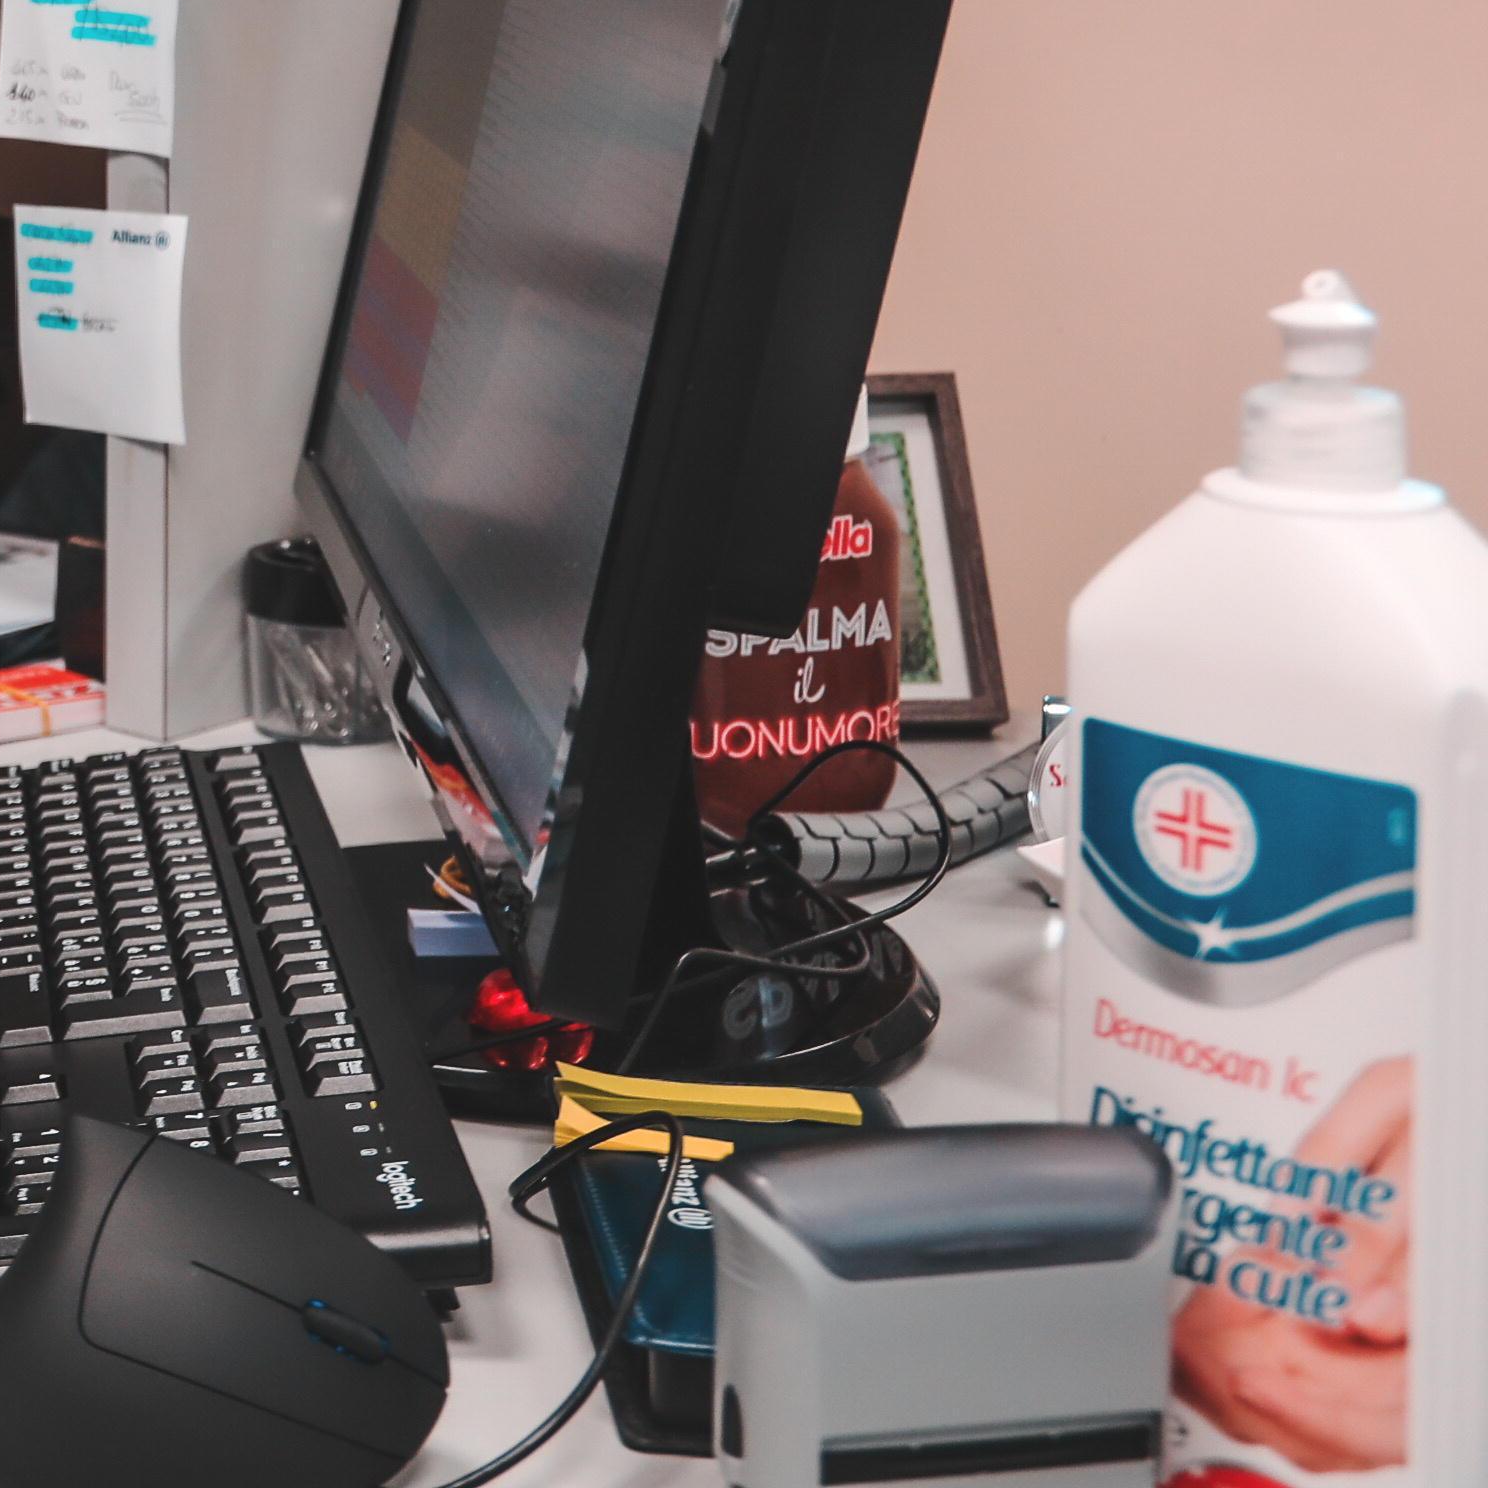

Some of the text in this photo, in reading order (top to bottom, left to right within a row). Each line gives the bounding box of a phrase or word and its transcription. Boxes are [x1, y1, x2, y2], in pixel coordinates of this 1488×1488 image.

[112, 229, 153, 246] Allianz
[688, 698, 901, 760] UONUMORE
[1093, 998, 1272, 1090] Dermosan
[377, 1161, 423, 1210] logitech
[1228, 1261, 1350, 1328] cute
